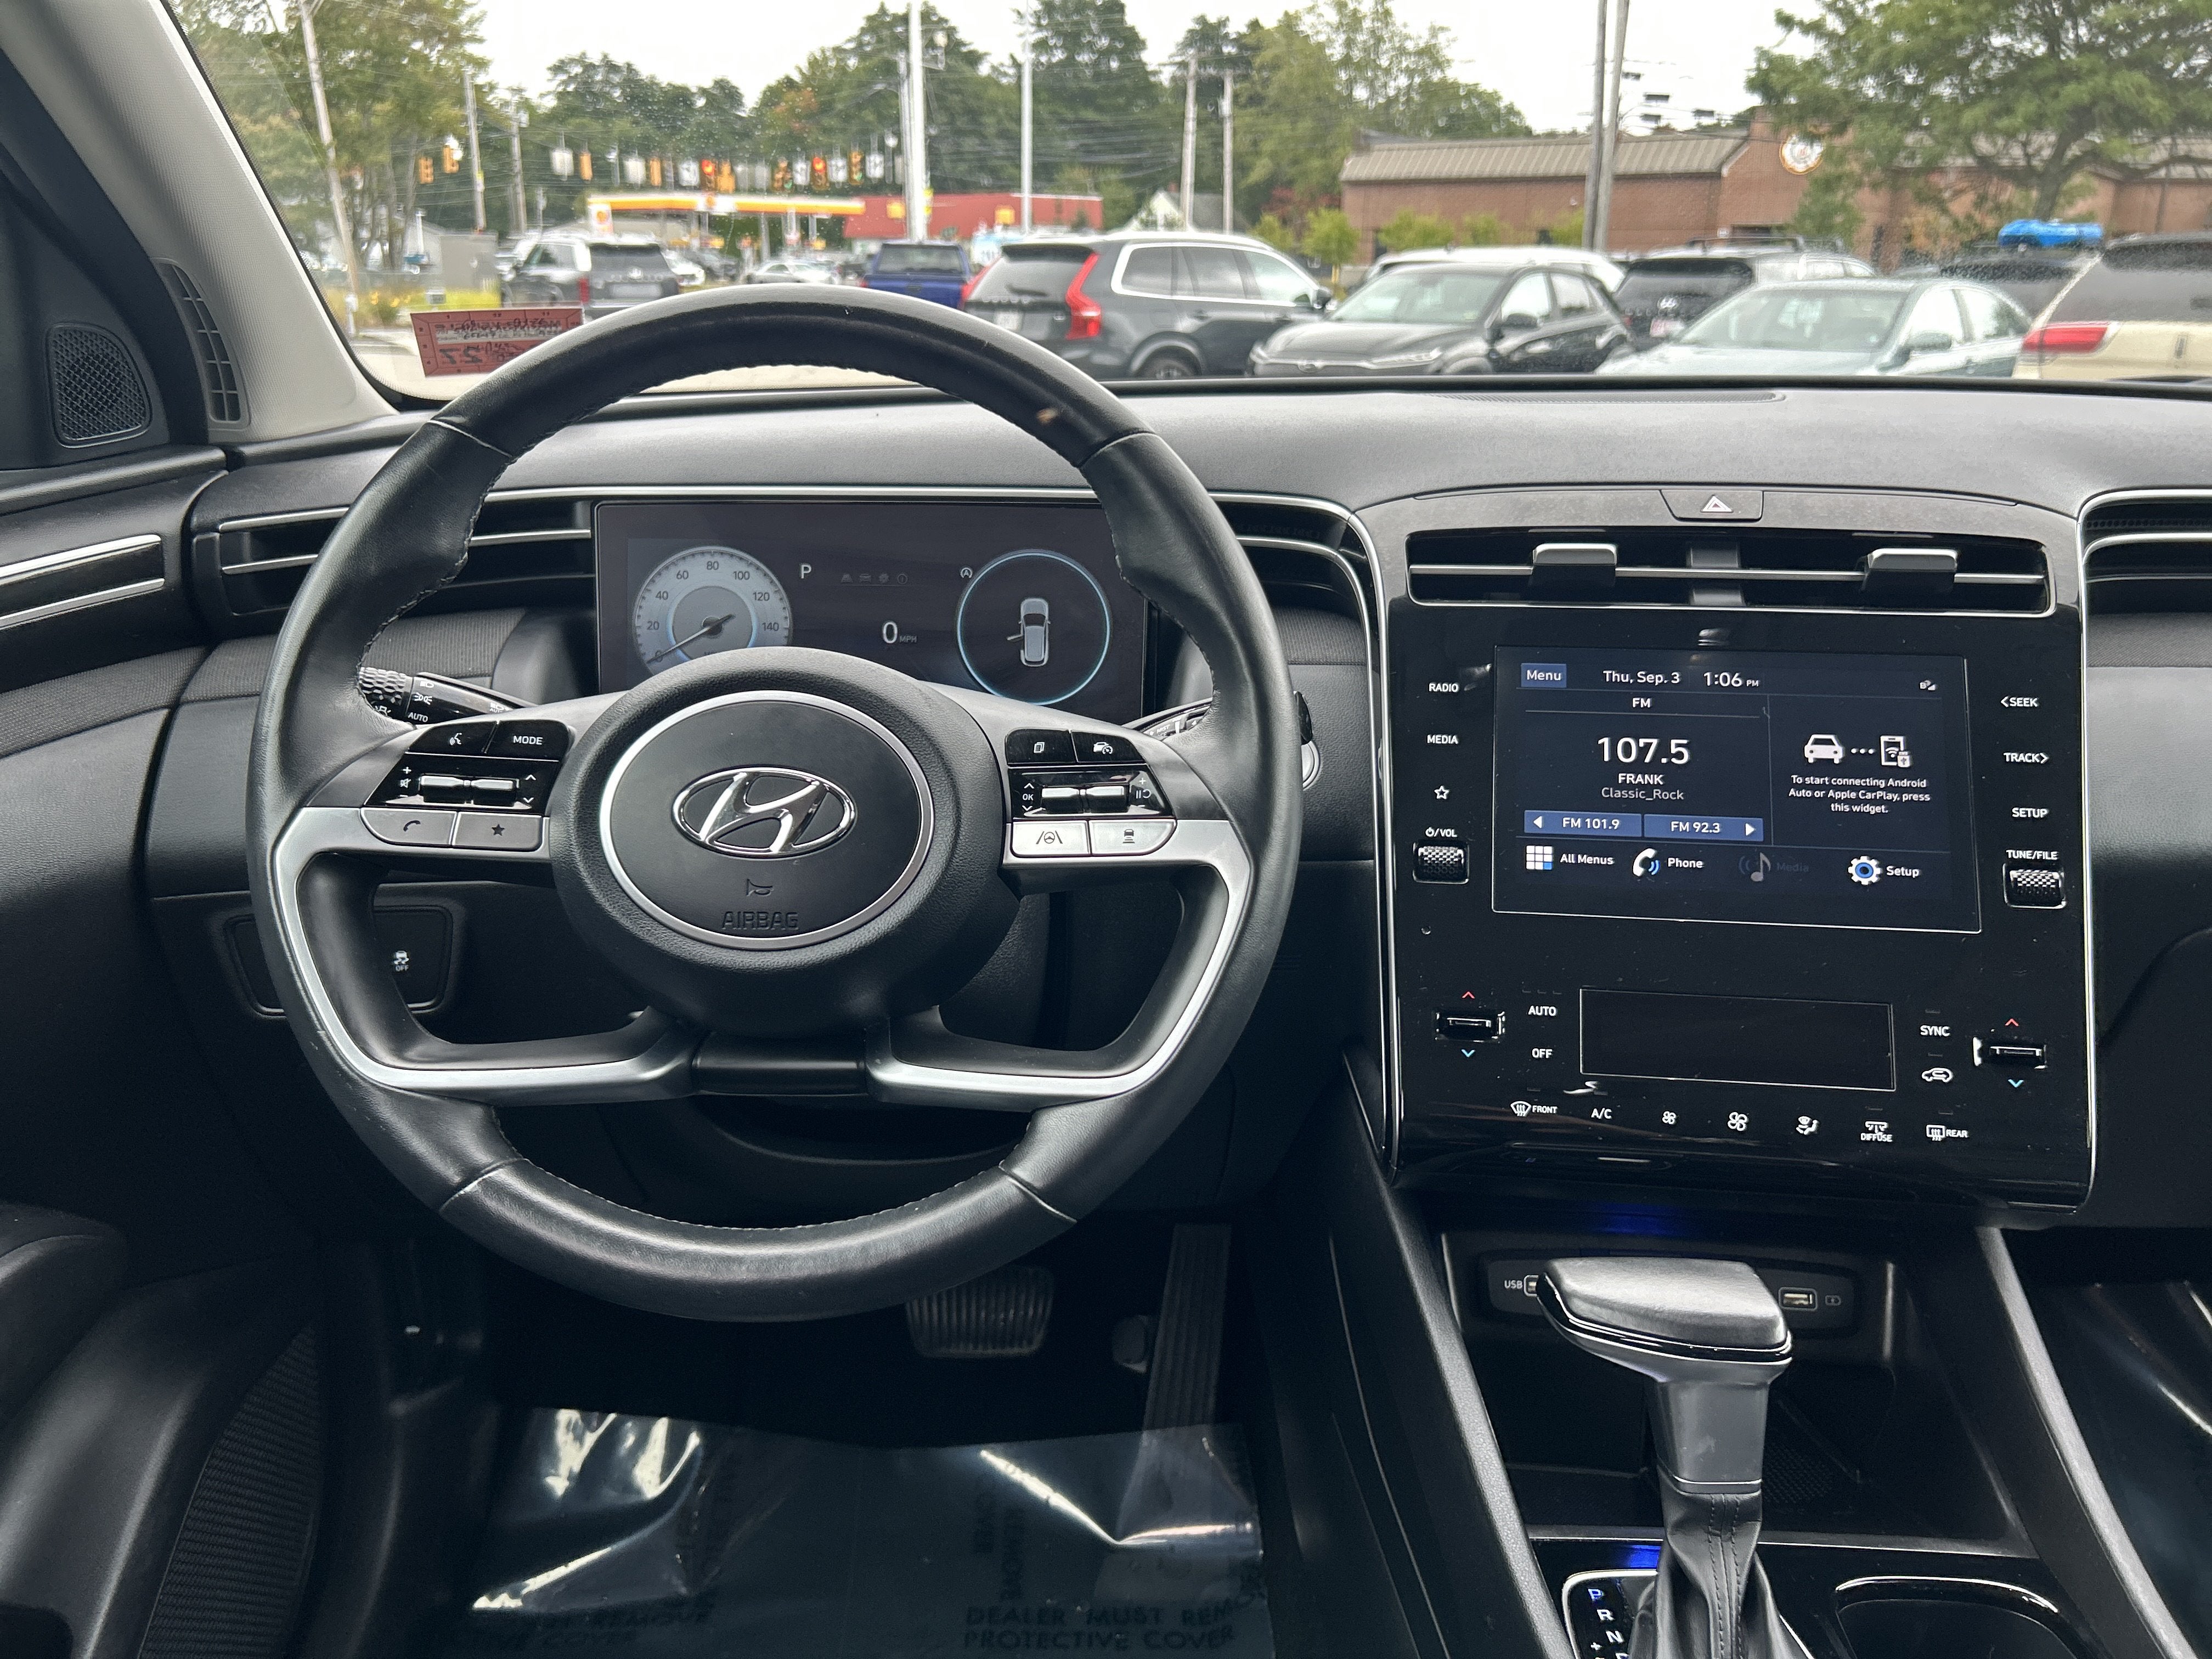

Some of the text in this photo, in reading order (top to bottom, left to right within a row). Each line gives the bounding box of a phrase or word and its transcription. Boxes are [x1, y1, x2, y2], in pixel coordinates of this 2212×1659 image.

[706, 561, 719, 571] 80
[801, 564, 812, 579] P
[676, 570, 689, 580] 60
[733, 571, 751, 580] 100
[655, 590, 669, 601] 40
[753, 591, 770, 601] 120
[647, 620, 660, 630] 20
[761, 622, 780, 631] 140
[883, 622, 898, 644] 0
[1527, 669, 1561, 681] Menu
[1602, 670, 1633, 684] Thu,
[1637, 671, 1668, 686] Sep.
[1671, 672, 1680, 684] 3
[1703, 672, 1742, 687] 1:06
[1429, 682, 1459, 692] RADIO
[1632, 697, 1651, 708] FM
[2009, 697, 2038, 707] SEEK
[408, 712, 428, 723] AUTO
[513, 735, 543, 745] MODE
[1427, 735, 1458, 744] MEDIA
[1598, 737, 1689, 764] 107.5
[2003, 752, 2040, 763] TRACK
[1618, 773, 1663, 785] FRANK
[1791, 775, 1927, 788] To start connecting Android
[1601, 787, 1684, 800] Classic_Rock
[1788, 788, 1812, 797] Auto
[1827, 789, 1857, 800] Apple
[1858, 790, 1900, 802] CarPlay,
[1902, 793, 1931, 802] press
[1831, 803, 1888, 815] this widget.
[2012, 807, 2049, 818] SETUP
[1562, 817, 1620, 830] FM 101.9
[1671, 821, 1720, 833] FM 92.3
[1560, 853, 1614, 865] All Menus
[2006, 849, 2058, 860] TUNE/FILE
[1668, 857, 1704, 868] Phone
[1886, 865, 1920, 878] Setup
[721, 911, 799, 930] AIRBAG
[1528, 1005, 1557, 1017] AUTO
[1920, 1025, 1950, 1037] SYNC
[1532, 1048, 1553, 1058] OFF
[1532, 1105, 1558, 1114] FRONT
[1591, 1108, 1612, 1119] A/C
[1860, 1132, 1893, 1142] DIFFUSE
[1945, 1129, 1968, 1138] REAR
[1504, 1280, 1523, 1289] USB
[1588, 1588, 1604, 1601] P
[966, 1606, 1065, 1626] DEALER
[1087, 1607, 1163, 1624] MUST
[1596, 1609, 1614, 1621] R
[964, 1629, 1128, 1651] PROTECTIVE
[1605, 1630, 1624, 1643] N
